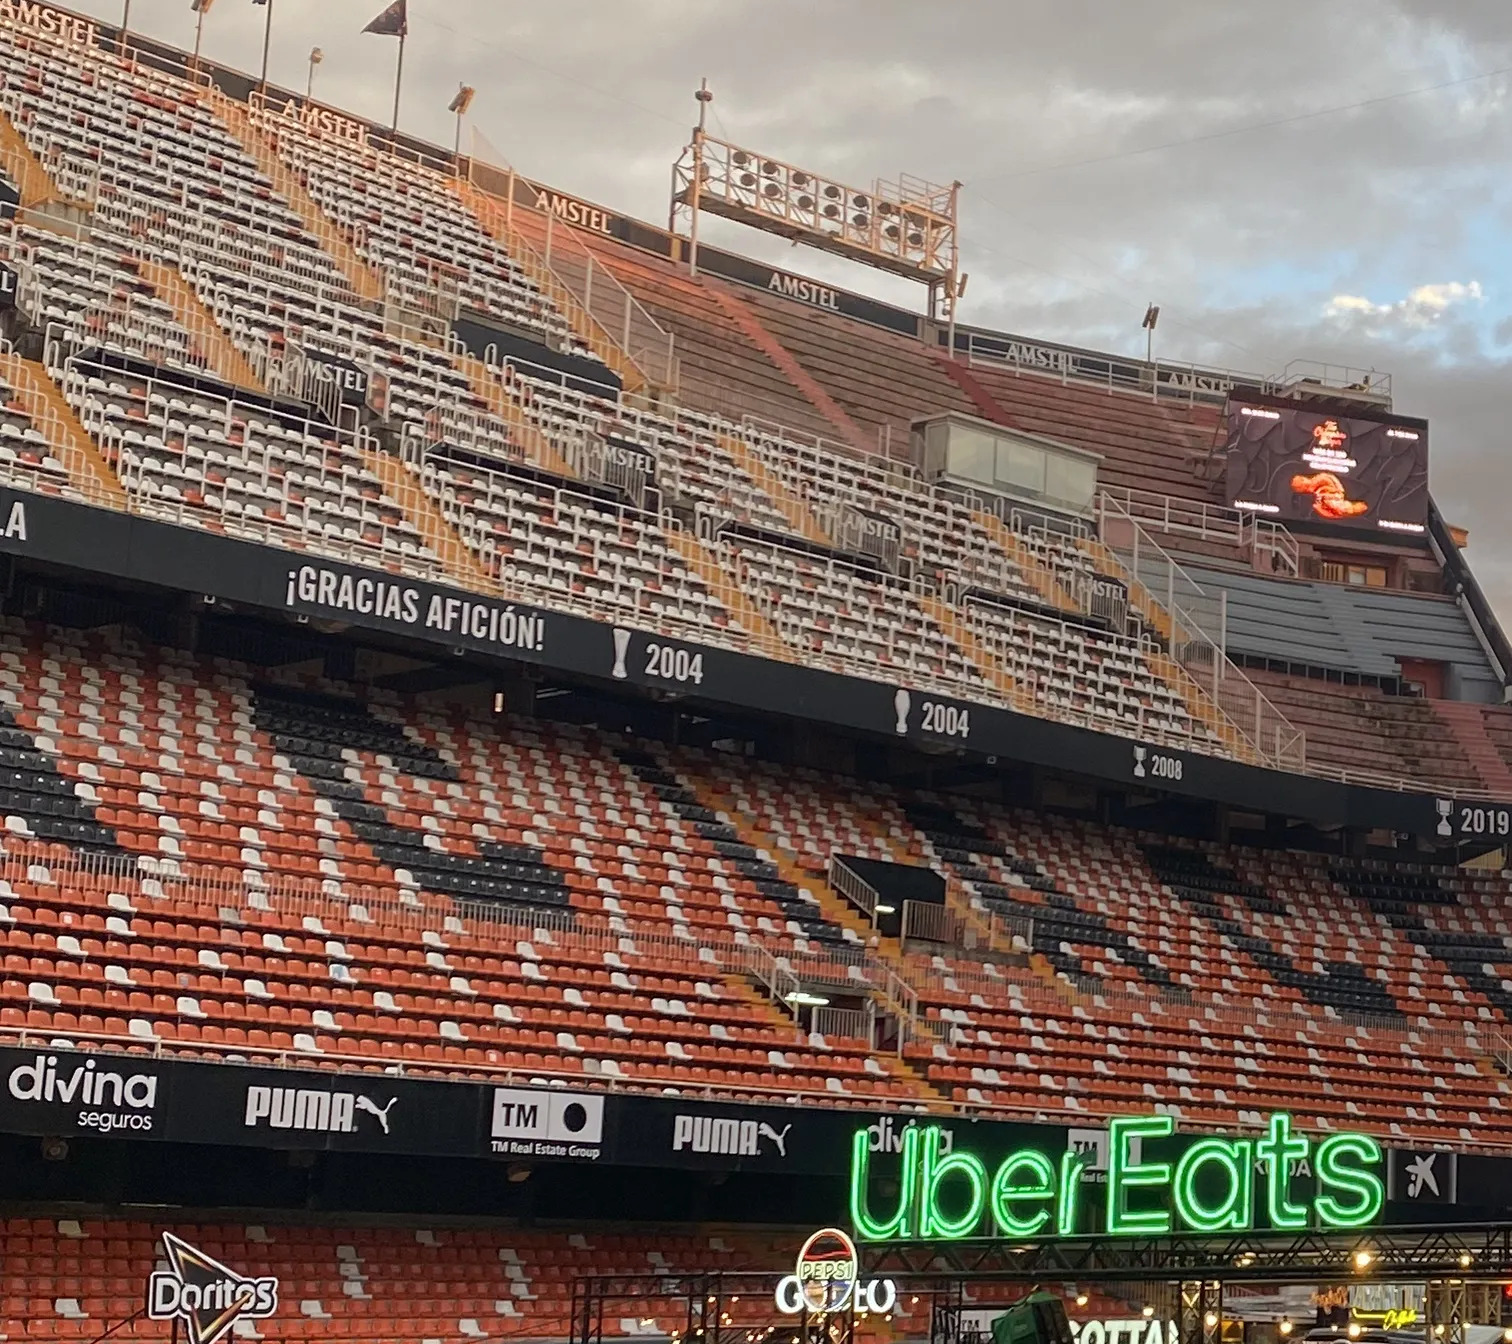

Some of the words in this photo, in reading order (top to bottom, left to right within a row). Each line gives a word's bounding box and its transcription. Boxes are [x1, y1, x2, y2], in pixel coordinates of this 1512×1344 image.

[282, 99, 369, 145] AMSTEL
[535, 191, 611, 233] AMSTEL
[768, 272, 839, 310] AMSTEL
[1005, 343, 1078, 373] AMSTEL
[286, 565, 420, 624] ¡GRACIAS
[425, 594, 544, 651] AFICIÓN!
[645, 642, 704, 685] 2004
[921, 701, 970, 739] 2004
[1151, 755, 1183, 782] 2008
[1460, 806, 1511, 836] 2019
[8, 1055, 158, 1109] divina
[77, 1110, 153, 1133] seguros
[244, 1086, 355, 1133] PUMA
[501, 1102, 538, 1129] TM
[491, 1140, 508, 1153] TM
[510, 1142, 533, 1154] Real
[535, 1143, 567, 1156] Estate
[568, 1145, 600, 1160] Group
[672, 1115, 758, 1156] PUMA
[867, 1116, 953, 1156] diva
[801, 1261, 854, 1280] PEPSI
[154, 1277, 273, 1313] Doritos
